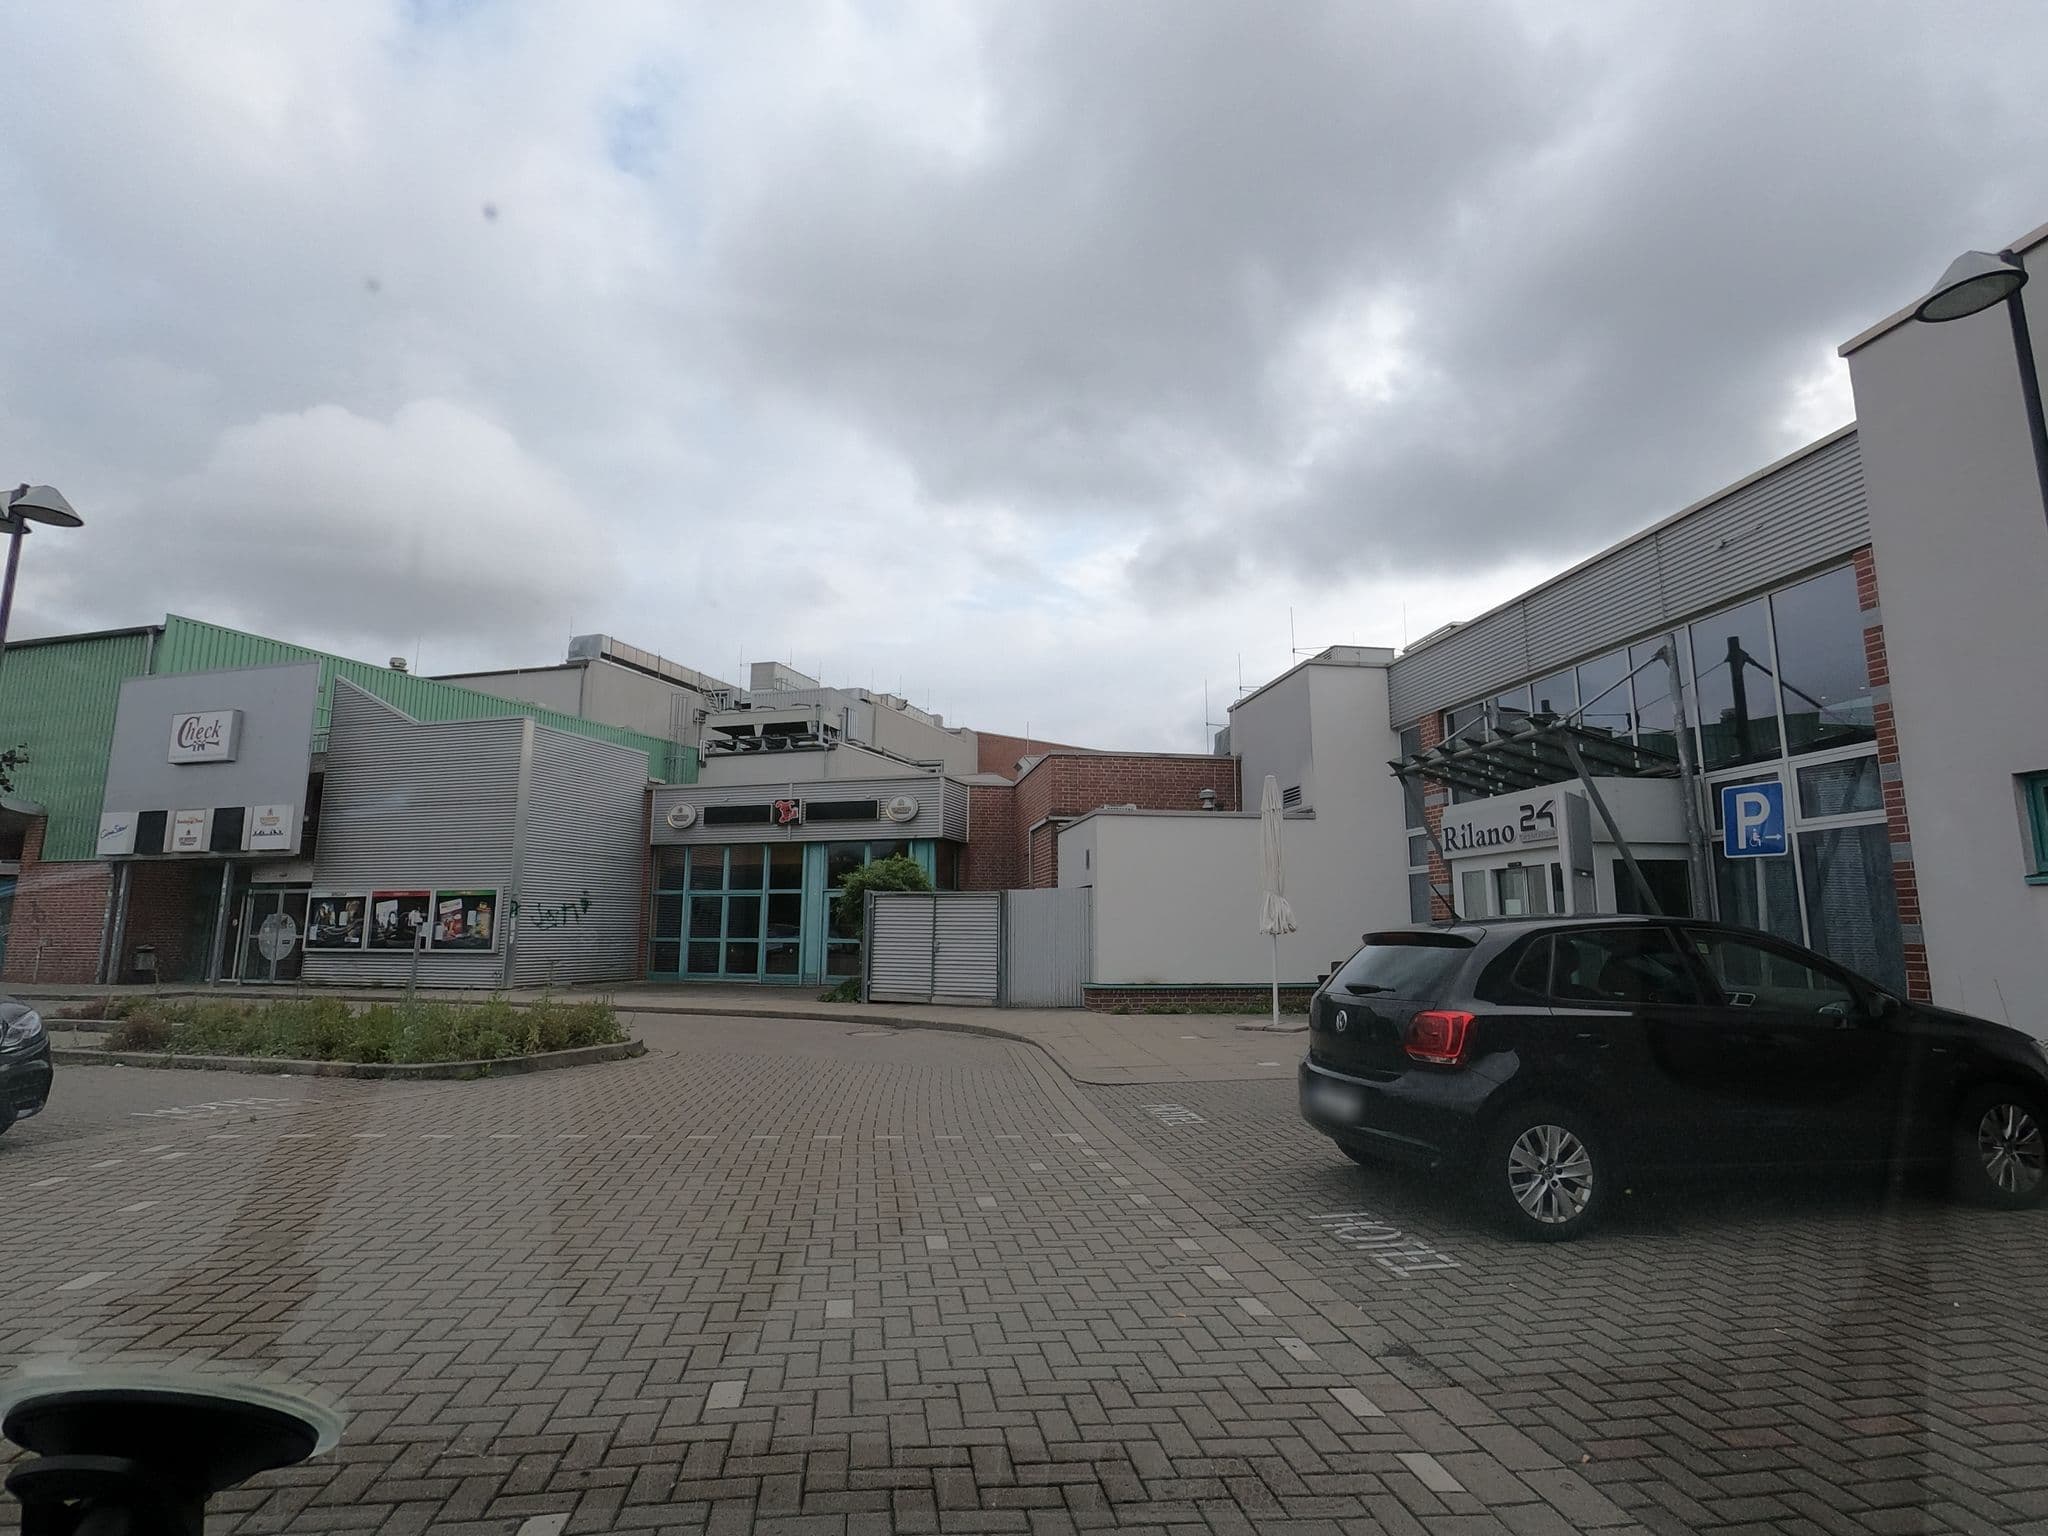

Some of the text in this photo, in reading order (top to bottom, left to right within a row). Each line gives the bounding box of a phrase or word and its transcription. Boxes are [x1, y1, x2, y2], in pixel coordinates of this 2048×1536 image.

[177, 716, 222, 748] Check
[1443, 822, 1515, 852] Rilano
[1519, 799, 1554, 832] 24
[1736, 792, 1770, 849] P
[1309, 1212, 1461, 1277] HOTEL
